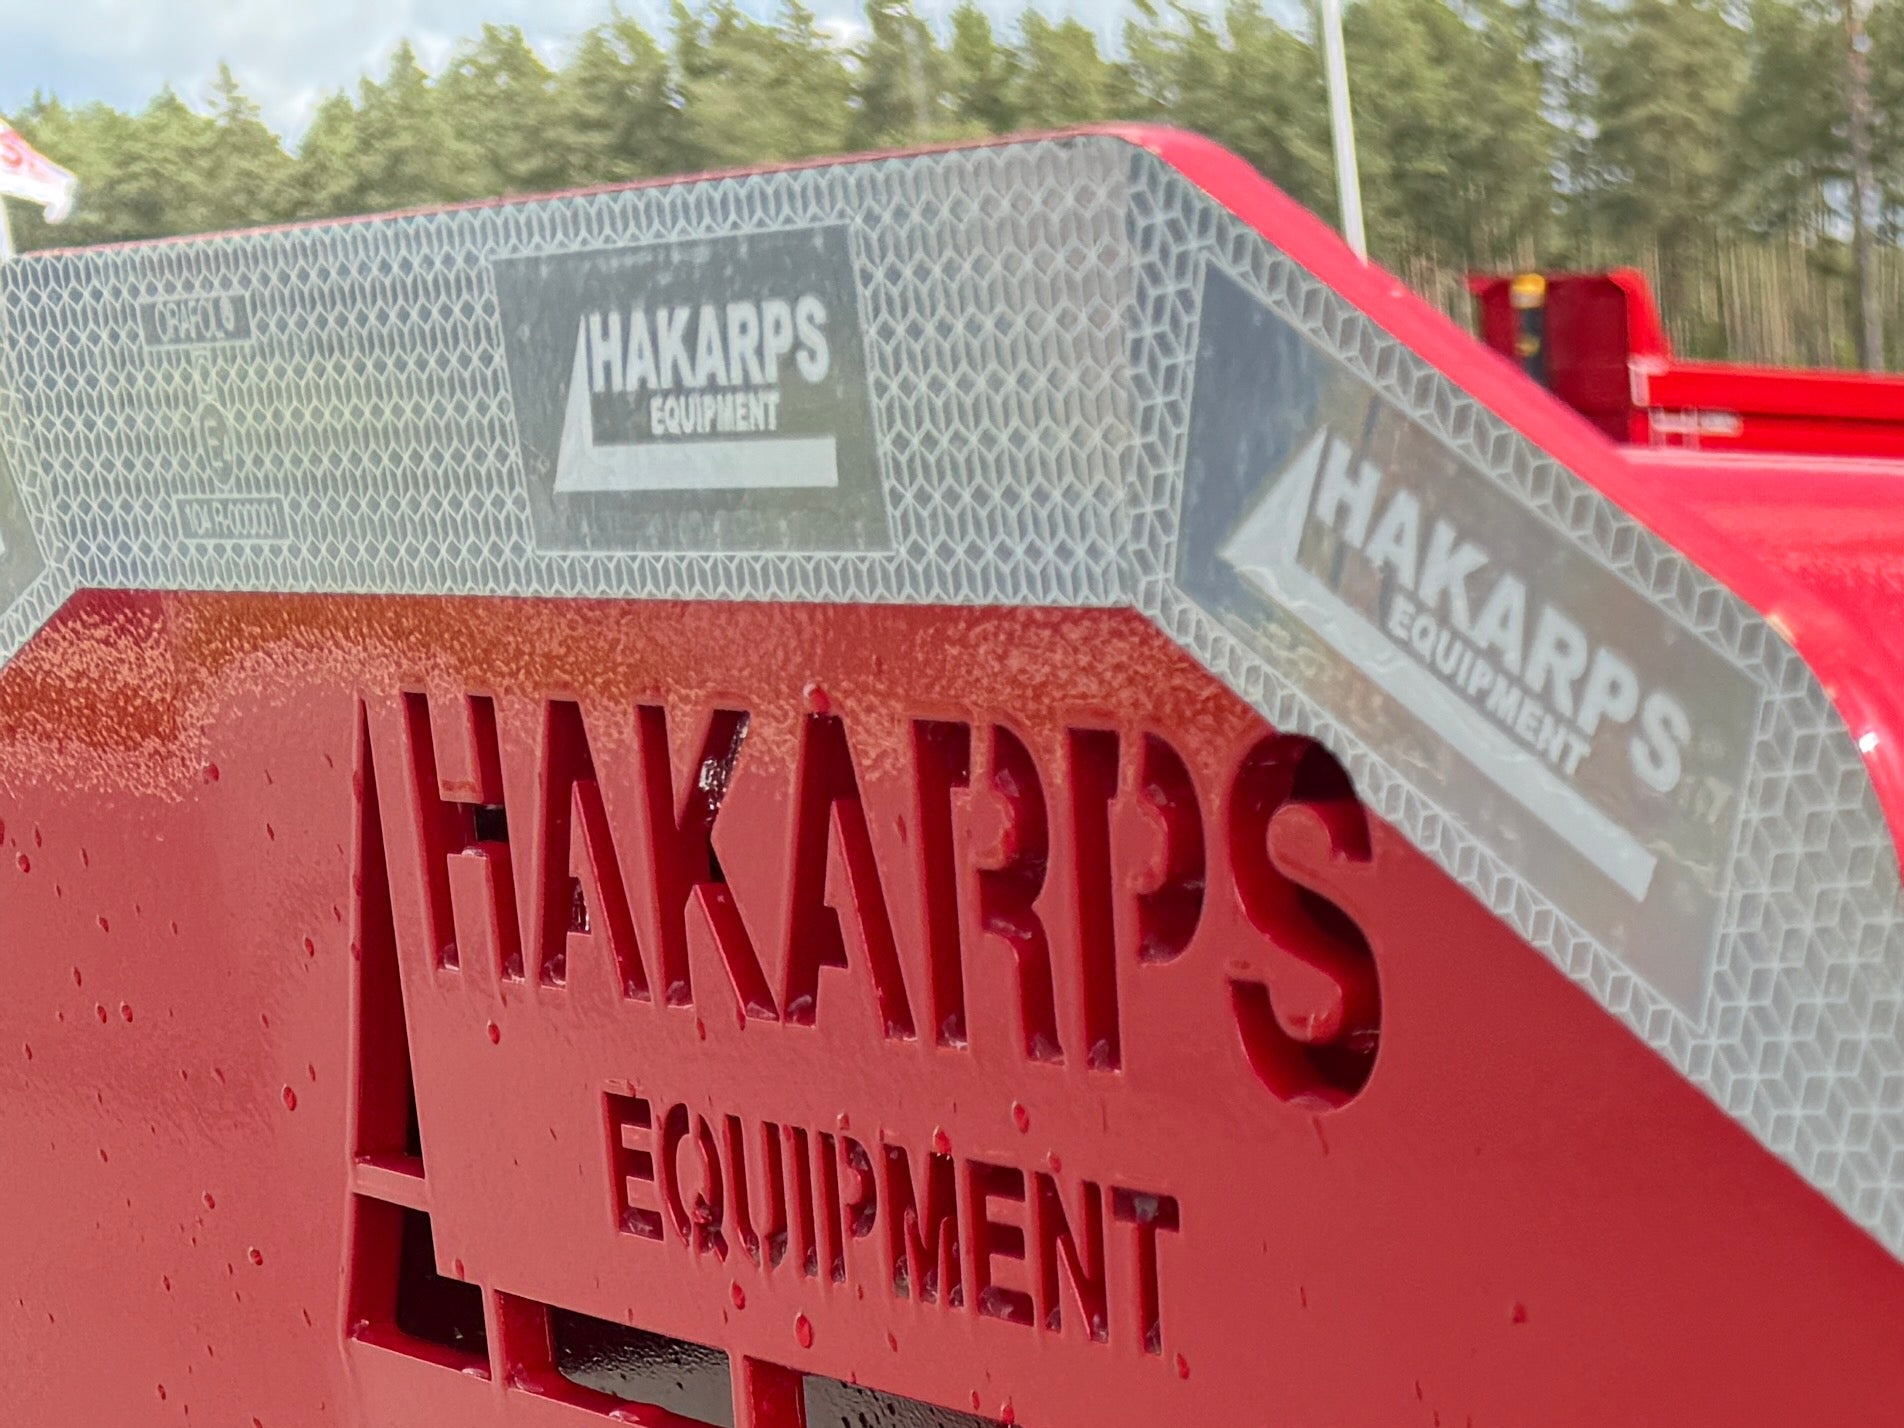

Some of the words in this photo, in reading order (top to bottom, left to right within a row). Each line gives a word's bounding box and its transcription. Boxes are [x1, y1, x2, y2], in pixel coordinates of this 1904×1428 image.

[589, 296, 830, 392] HAKARPS
[651, 391, 780, 435] EQUIPMENT
[1314, 436, 1691, 793] HAKARPS
[1388, 594, 1592, 775] EQUIPMENT
[404, 690, 1382, 1112] HAKARPS
[604, 1091, 1181, 1354] EQUIPMENT
